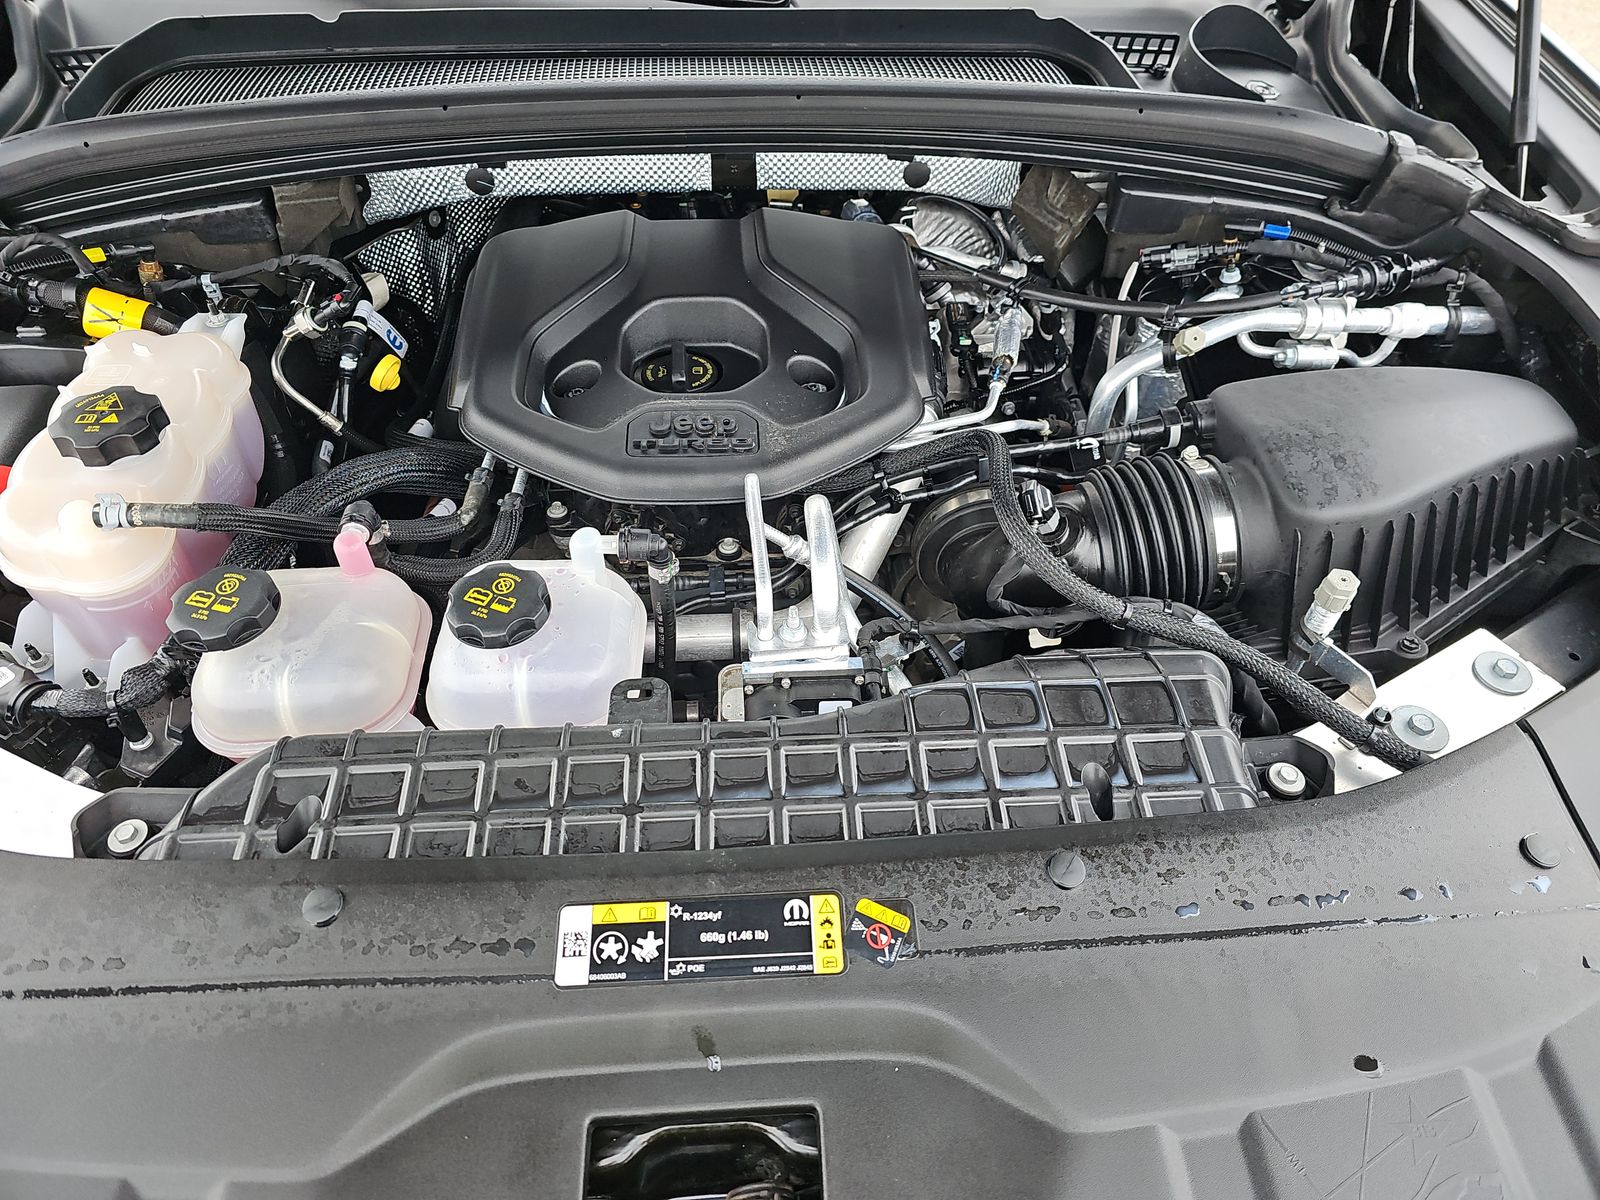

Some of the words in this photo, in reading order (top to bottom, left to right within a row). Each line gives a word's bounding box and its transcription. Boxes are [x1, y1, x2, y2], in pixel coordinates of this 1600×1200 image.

[648, 410, 740, 438] Jeep
[682, 910, 723, 922] R-1234yf
[699, 931, 727, 945] 660g
[727, 930, 754, 944] (1.46
[754, 929, 769, 942] lb)
[687, 963, 706, 973] POE
